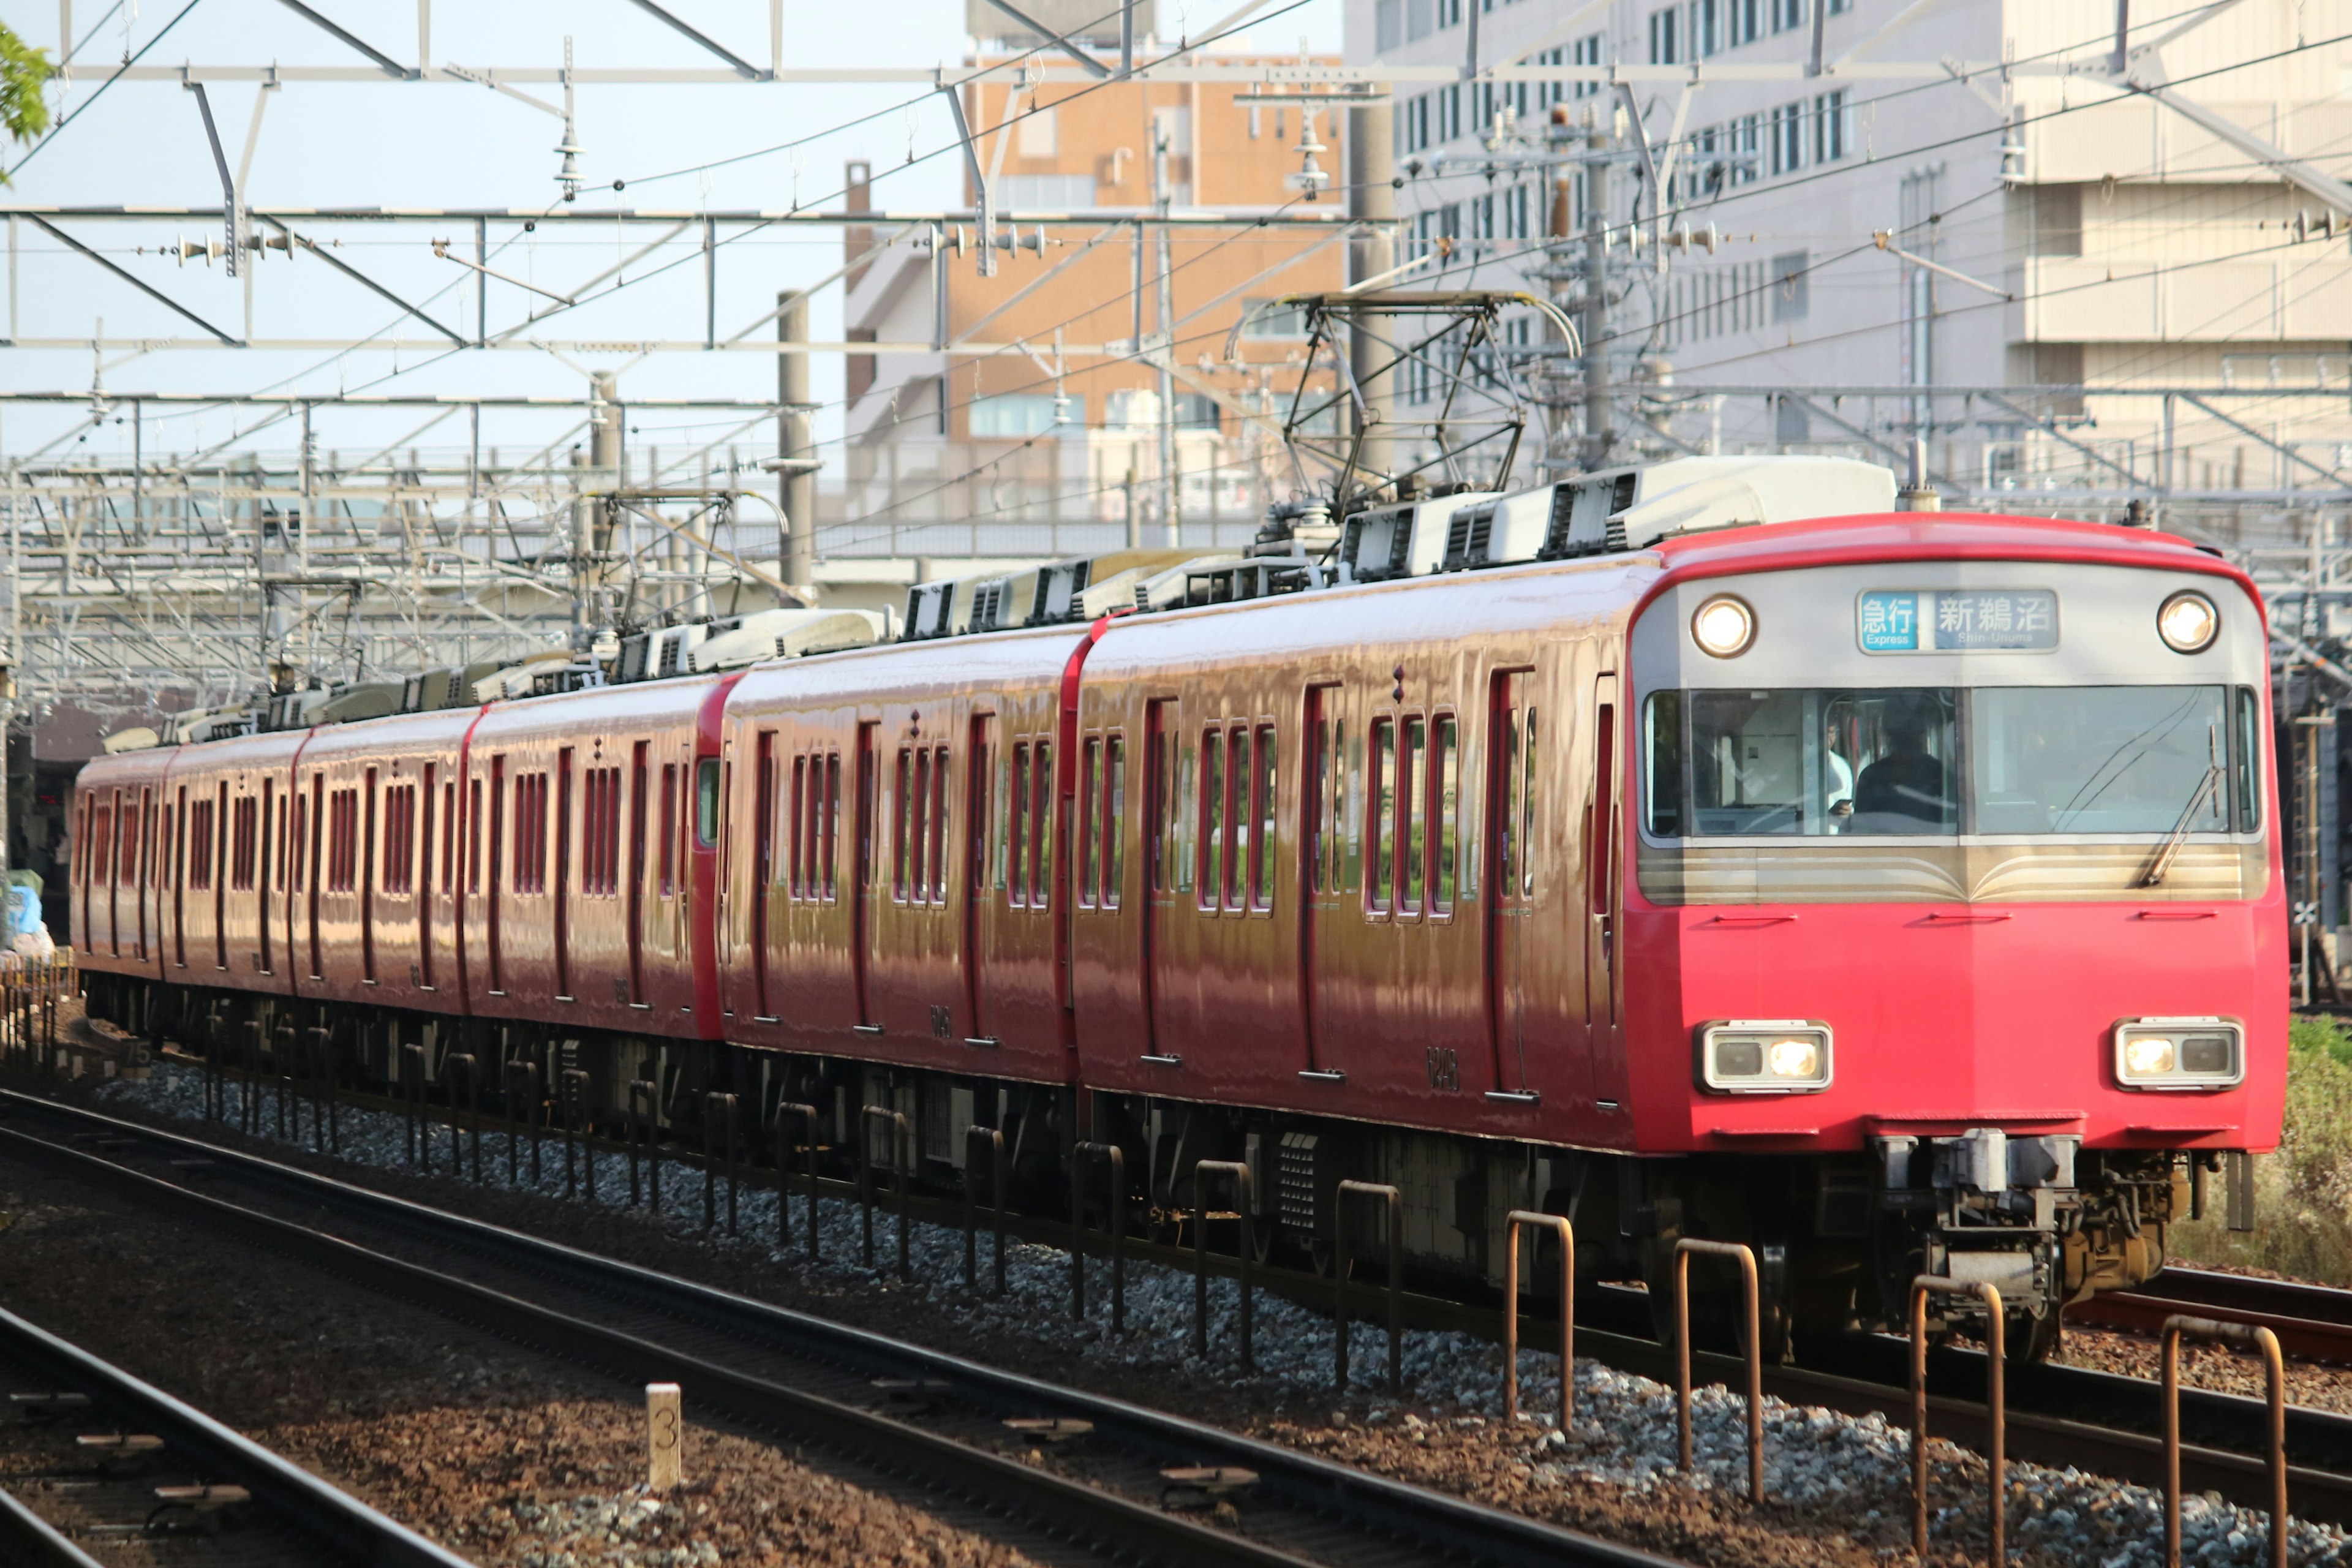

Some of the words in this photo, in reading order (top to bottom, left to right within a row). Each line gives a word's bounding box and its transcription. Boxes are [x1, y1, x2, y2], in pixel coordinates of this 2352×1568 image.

[1863, 598, 1913, 633] 急行
[1939, 596, 2050, 632] 新鵜沼
[1866, 633, 1909, 646] Express
[1958, 632, 2033, 643] Shin-Unuma
[655, 1408, 677, 1450] 3
